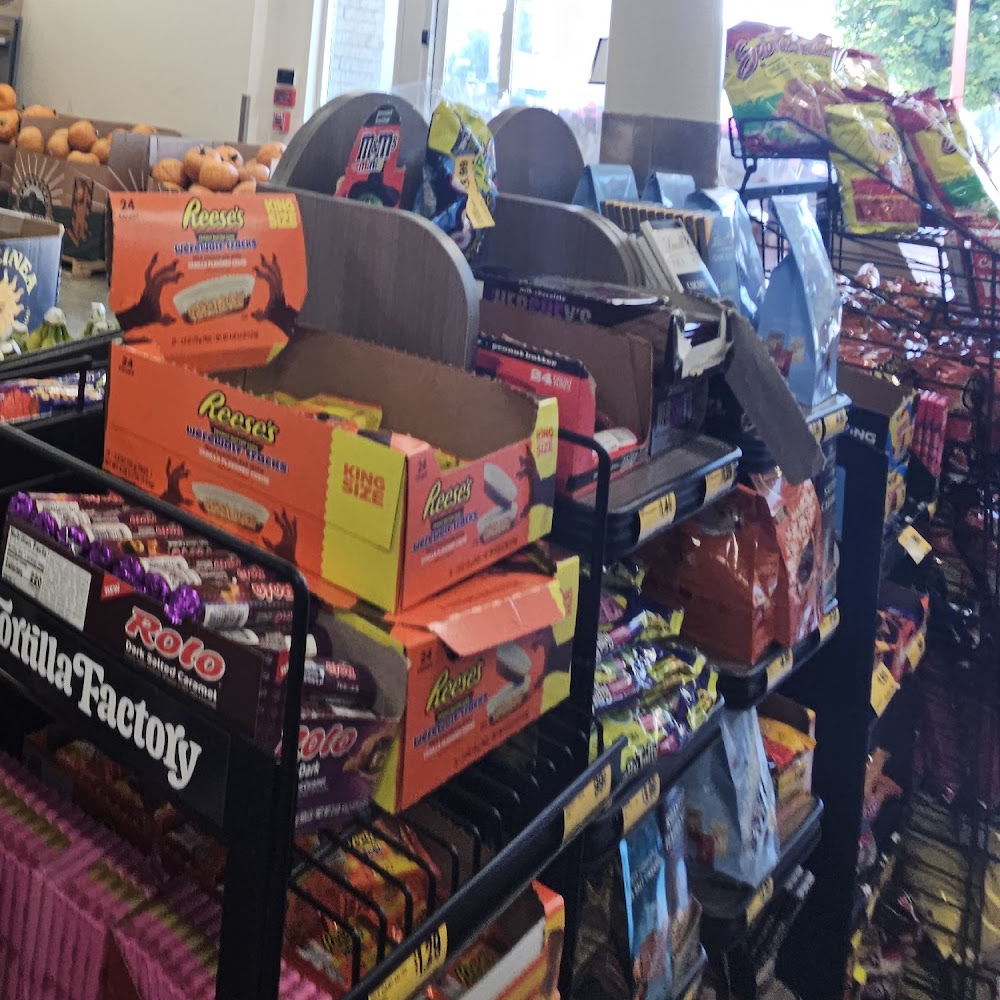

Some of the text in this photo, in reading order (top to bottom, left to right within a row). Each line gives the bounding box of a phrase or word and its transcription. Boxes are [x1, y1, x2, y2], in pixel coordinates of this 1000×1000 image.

[182, 197, 246, 231] Reese's
[198, 389, 281, 446] Reese's
[342, 480, 384, 508] SIZE
[343, 462, 386, 490] KING
[422, 474, 474, 521] Reese's
[103, 582, 121, 595] NEW
[125, 639, 218, 702] Dark Salted Caramel
[425, 657, 485, 715] Reese's
[73, 652, 203, 790] Factory
